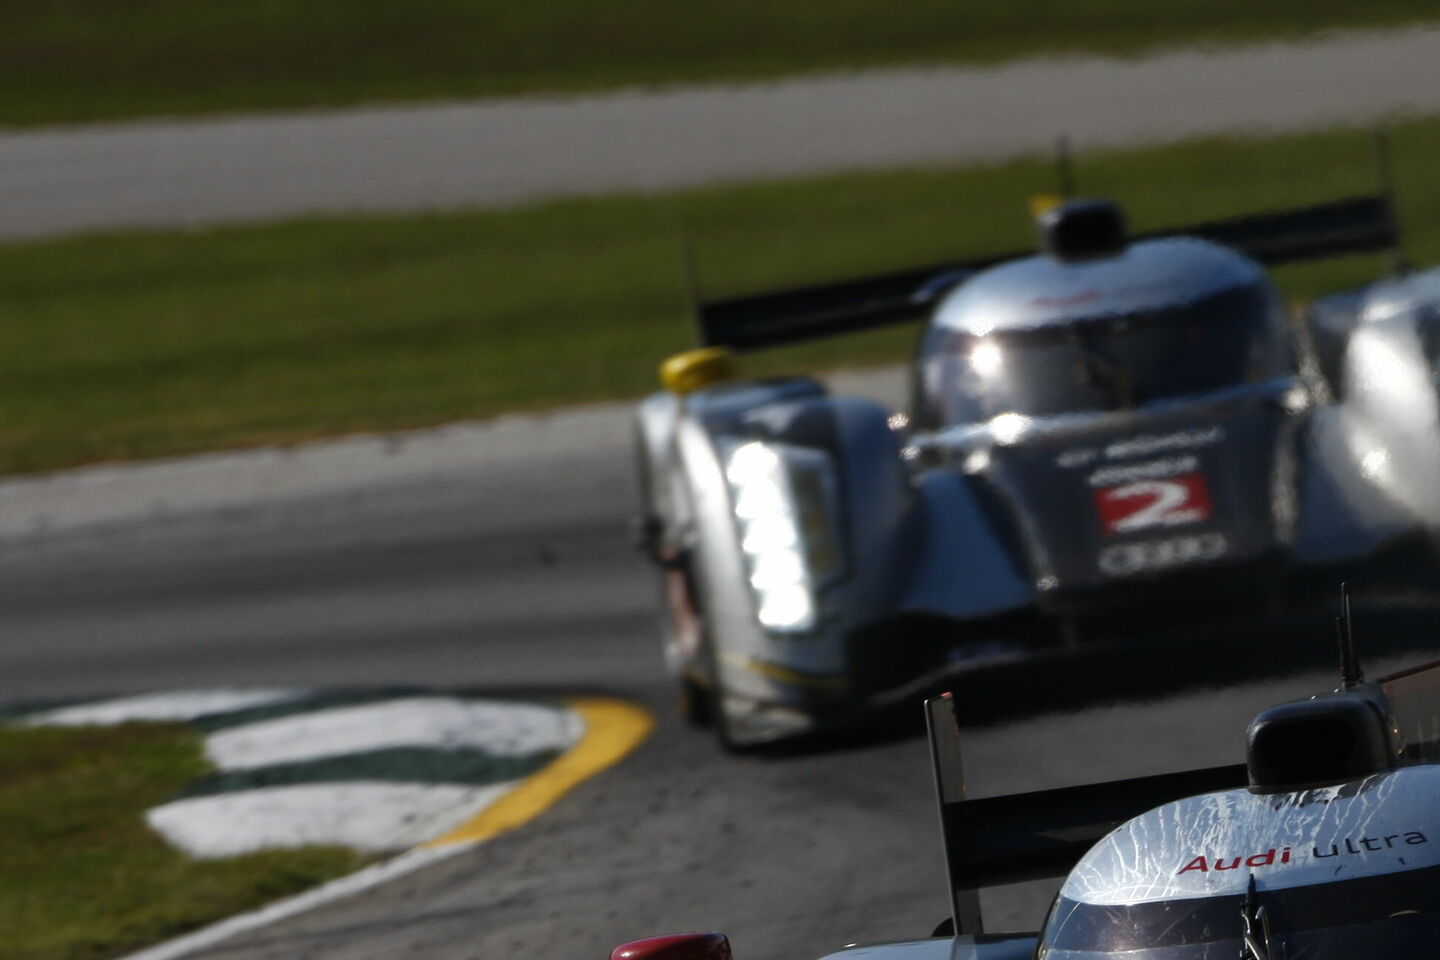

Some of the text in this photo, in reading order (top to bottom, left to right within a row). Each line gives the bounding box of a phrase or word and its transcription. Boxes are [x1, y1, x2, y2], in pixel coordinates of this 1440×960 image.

[1106, 480, 1207, 532] 2
[1178, 831, 1428, 875] Audi ultra
